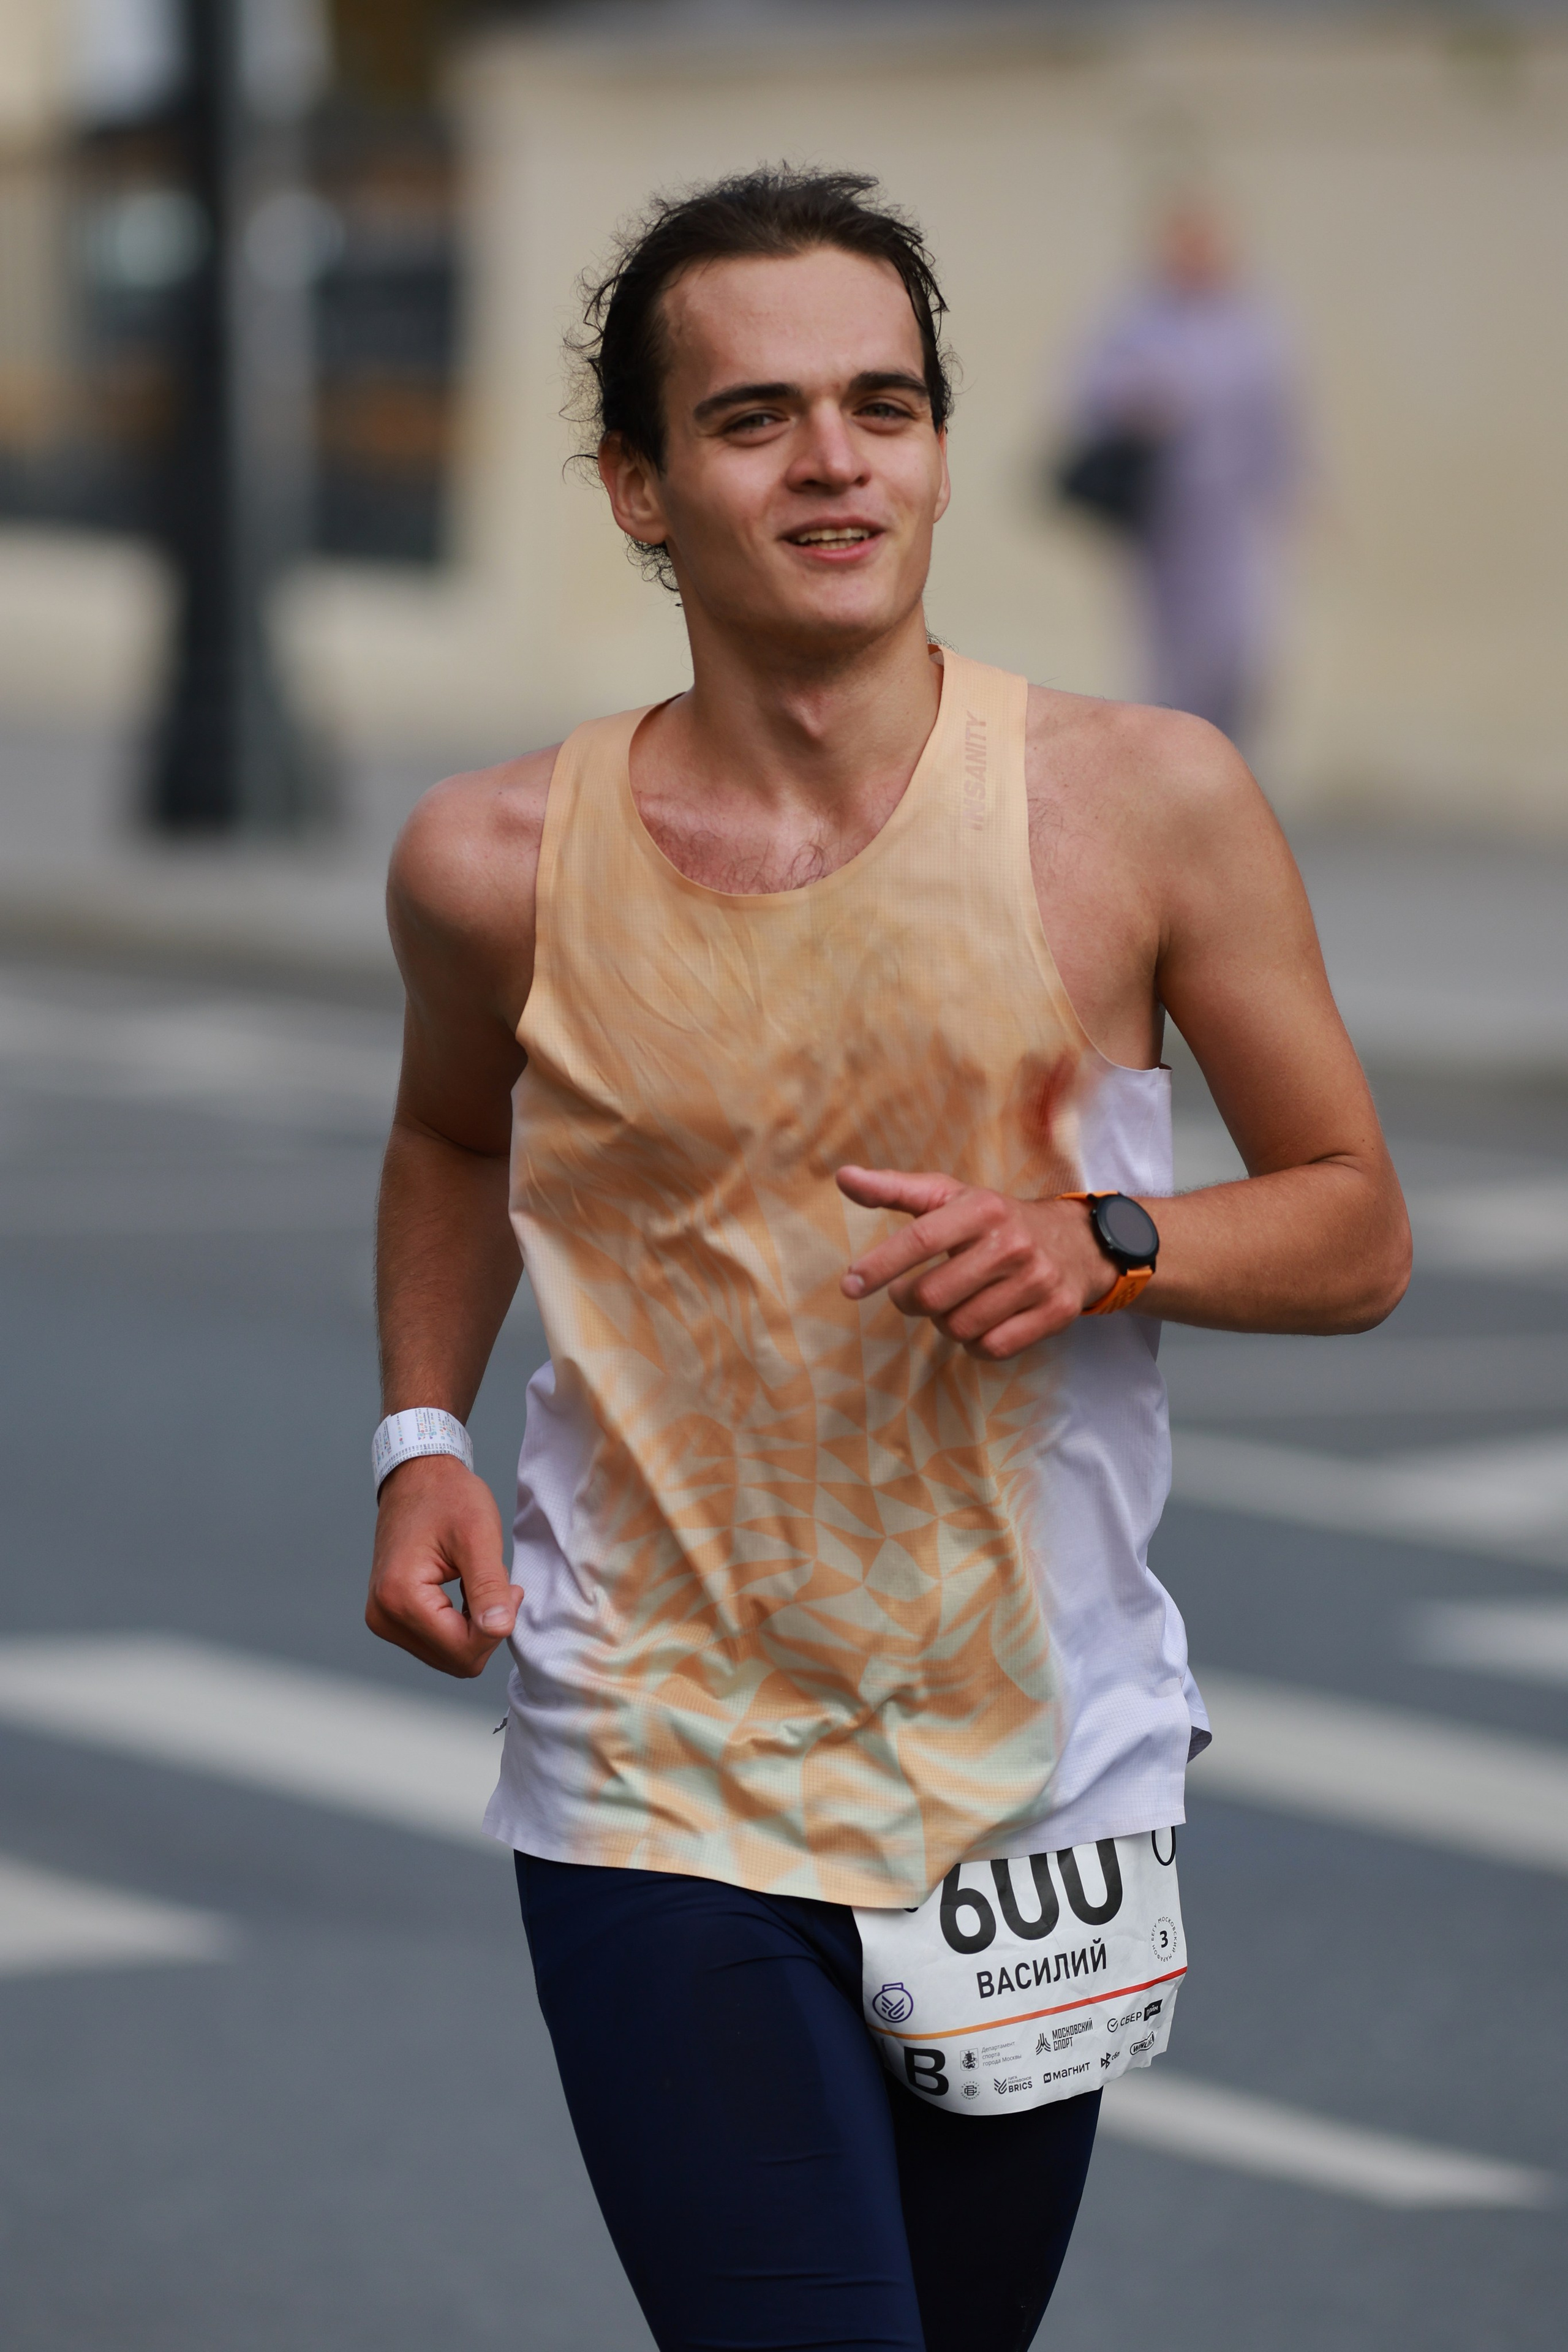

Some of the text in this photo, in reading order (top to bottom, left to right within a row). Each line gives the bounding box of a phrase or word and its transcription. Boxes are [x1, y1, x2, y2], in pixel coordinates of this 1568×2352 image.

[940, 1838, 1123, 1954] 600
[1159, 1930, 1169, 1948] 3
[976, 1937, 1107, 1999] ВАСИЛИЙ
[1120, 2011, 1142, 2026] СБЕР
[1052, 2018, 1093, 2040] МОСКОВСКИЙ
[981, 2041, 1016, 2054] Департамент
[1053, 2037, 1073, 2051] СПОРТ
[1001, 2054, 1022, 2062] Москвы
[1008, 2076, 1032, 2084] МАРАФОНОВ
[1008, 2081, 1033, 2093] BRICS
